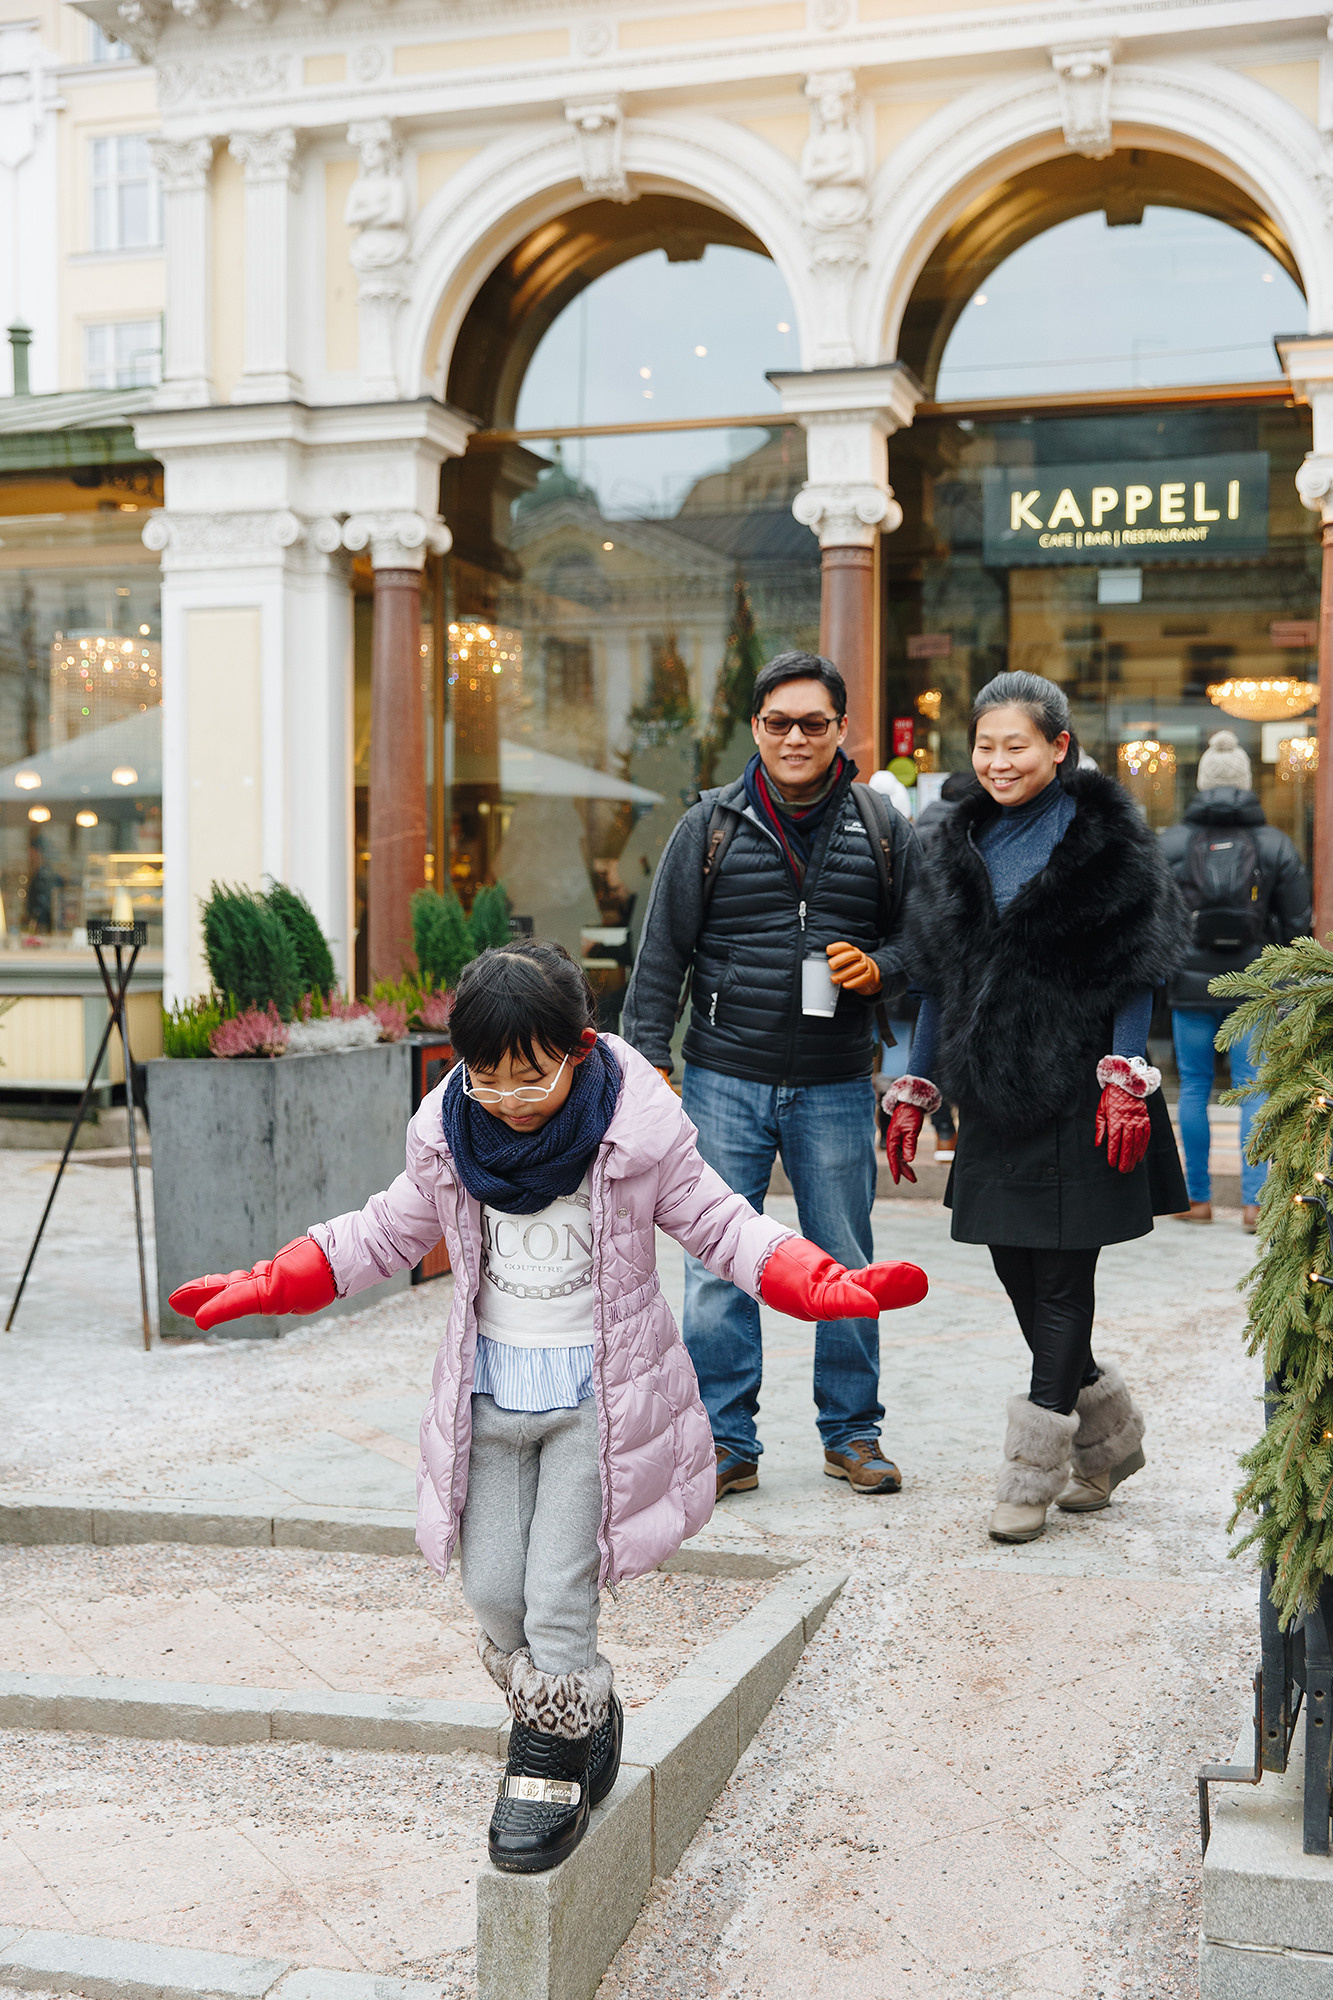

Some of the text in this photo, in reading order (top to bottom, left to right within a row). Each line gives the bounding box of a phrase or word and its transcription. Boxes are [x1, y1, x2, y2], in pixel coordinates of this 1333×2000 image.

[1010, 479, 1240, 531] KAPPELI
[1038, 526, 1210, 549] CAFE BAR RESTAURANT
[483, 1214, 594, 1261] ICON
[504, 1262, 564, 1274] COUTURE
